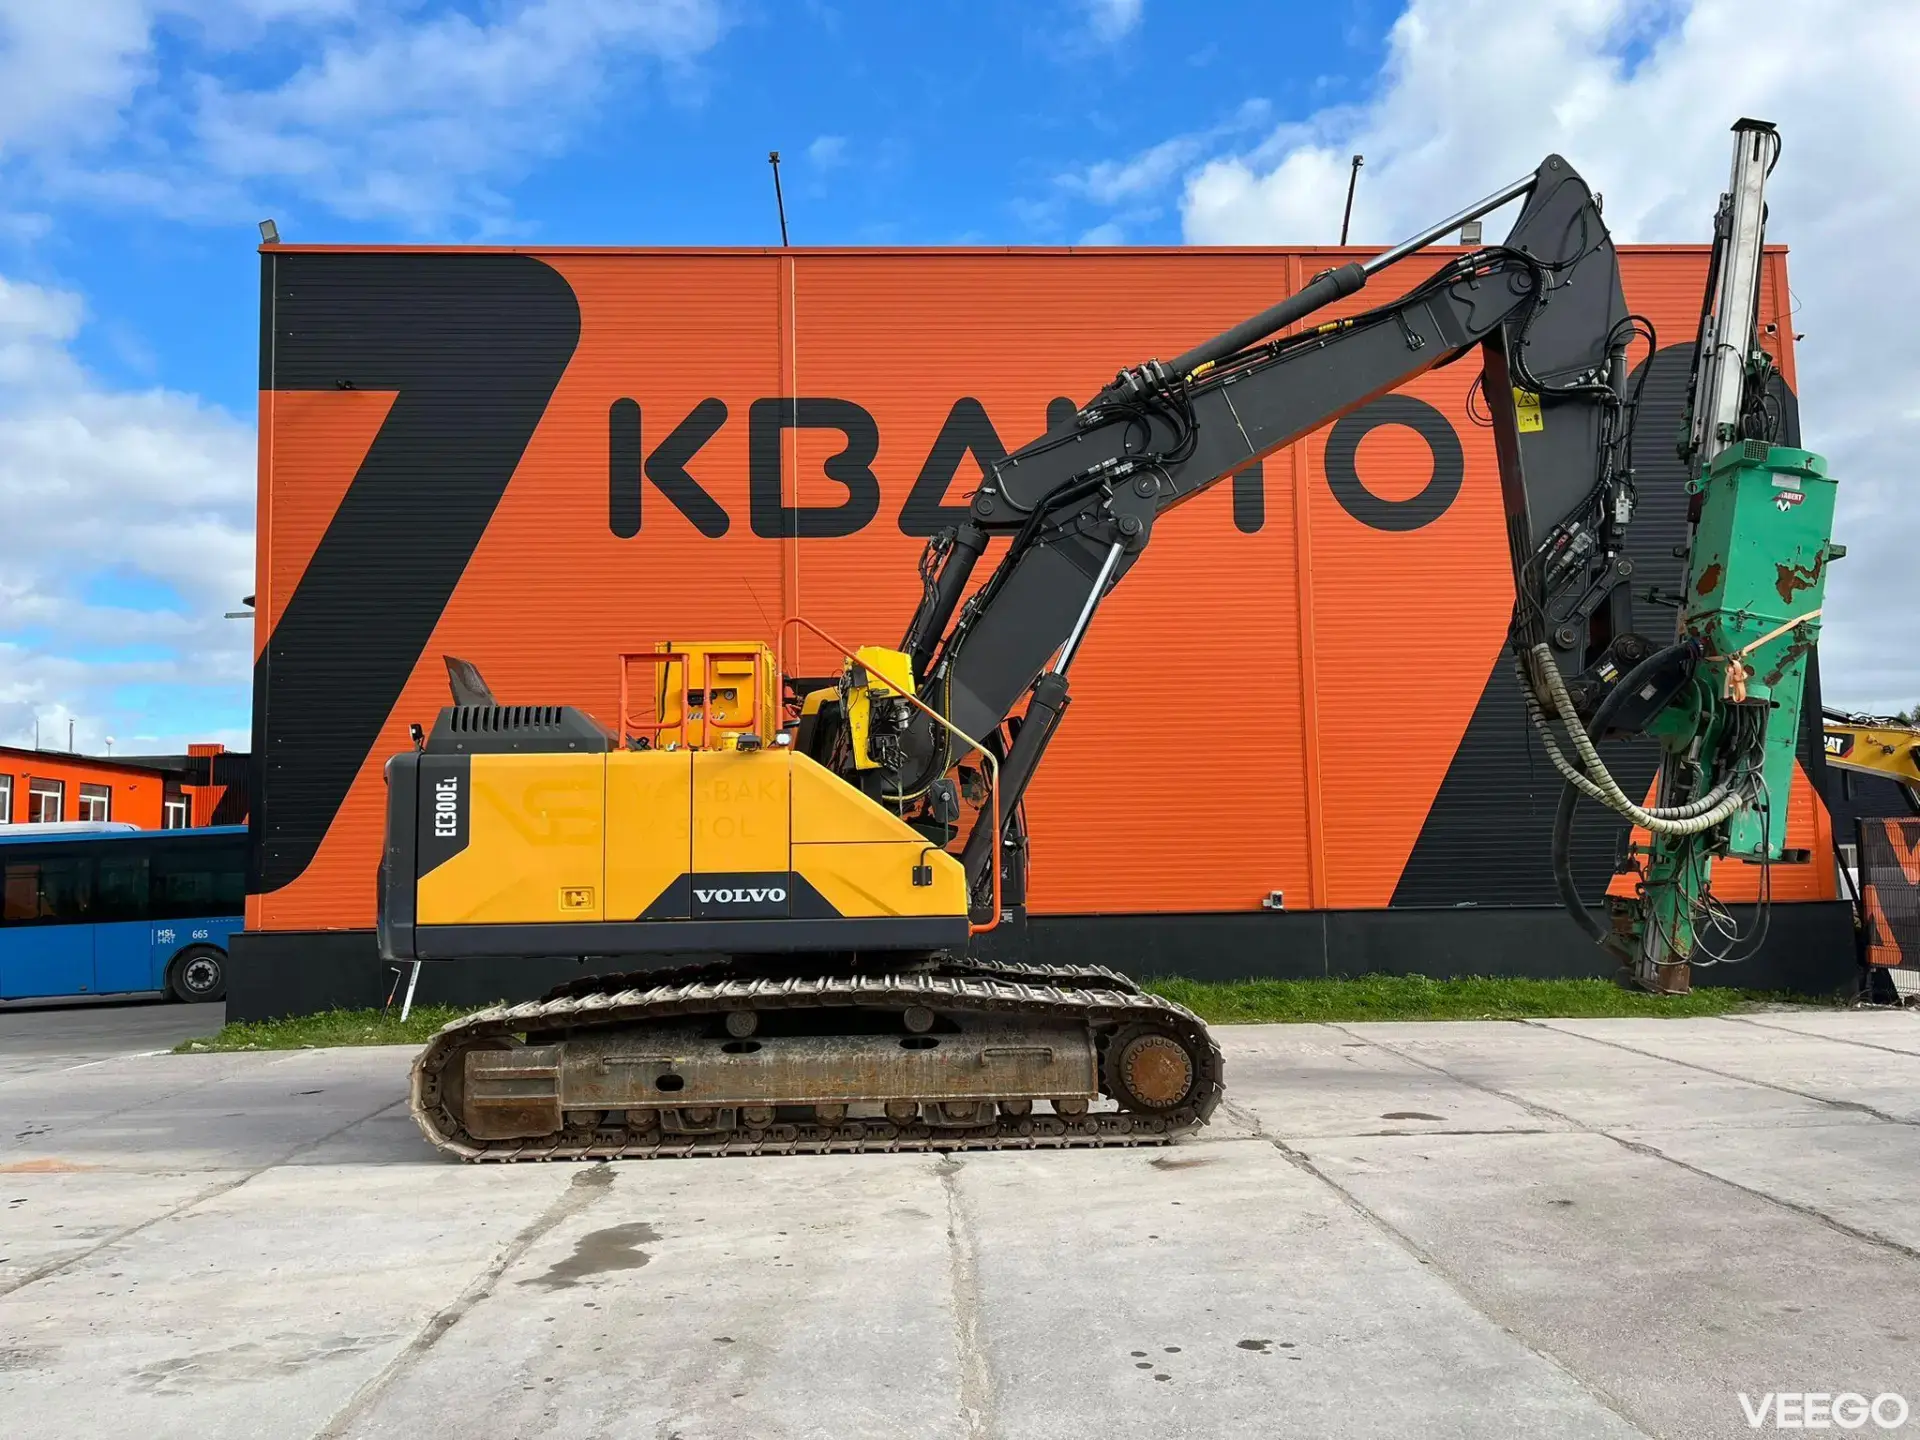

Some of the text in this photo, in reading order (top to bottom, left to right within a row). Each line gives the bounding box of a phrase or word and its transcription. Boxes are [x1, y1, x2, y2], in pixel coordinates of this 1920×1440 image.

[608, 393, 1465, 539] KBAO
[692, 888, 787, 903] VOLVO
[157, 928, 209, 939] HSL 665
